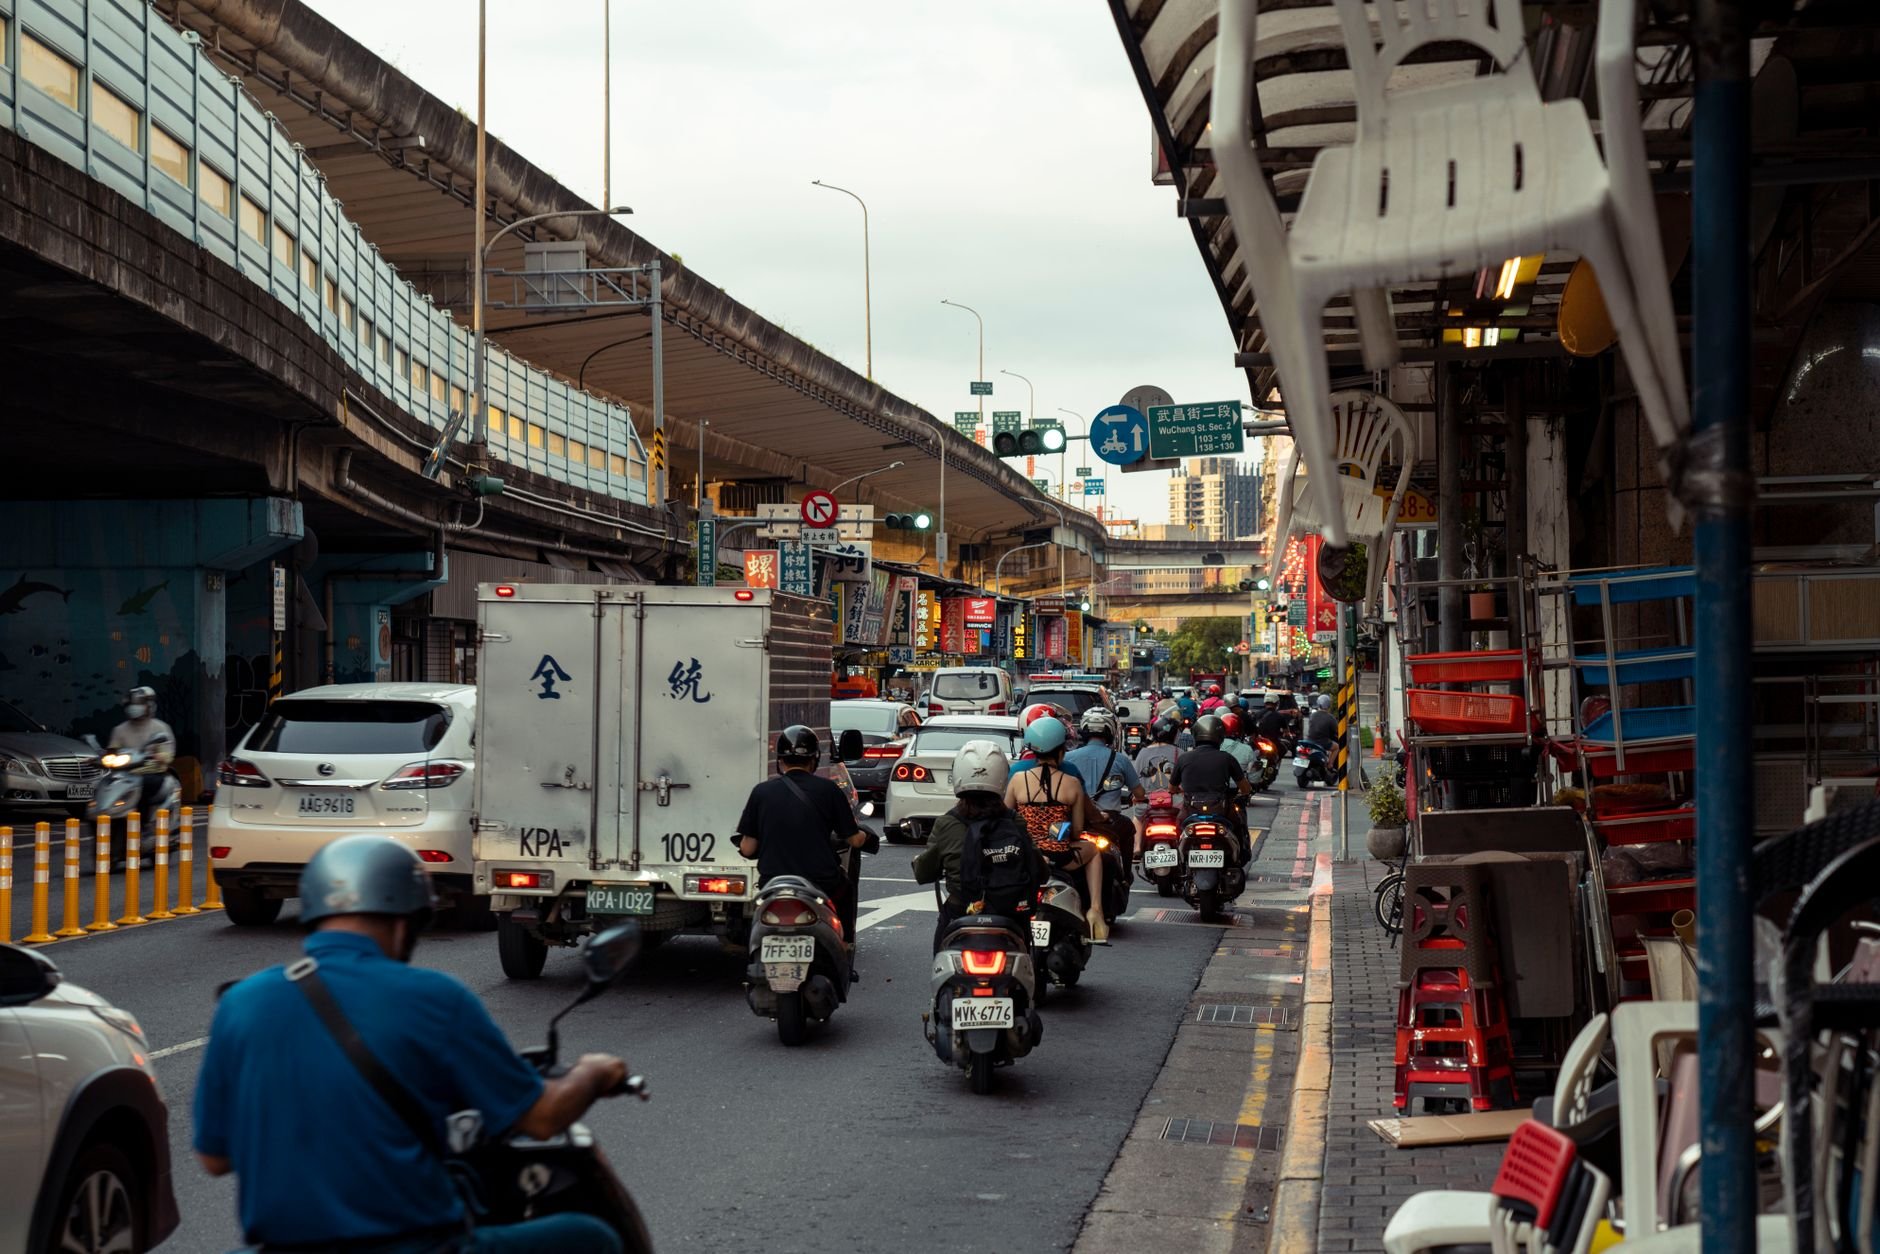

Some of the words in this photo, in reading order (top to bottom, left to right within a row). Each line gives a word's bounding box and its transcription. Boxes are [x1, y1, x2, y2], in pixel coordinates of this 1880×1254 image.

[1157, 405, 1231, 422] 武昌街二段
[1159, 425, 1196, 435] WuChang
[1197, 424, 1207, 432] St.
[1208, 423, 1225, 431] Sec.
[1226, 421, 1231, 429] 2
[803, 532, 835, 541] 禁止右轉
[747, 554, 775, 588] 螺
[530, 654, 572, 699] 全
[667, 657, 711, 703] 統
[661, 833, 715, 862] 1092
[1146, 854, 1176, 864] ENP-2228
[1189, 854, 1223, 864] NKR-1999
[587, 891, 653, 913] KPA-1092
[763, 944, 812, 959] 7FF-318
[954, 1006, 1011, 1022] MVK-6776
